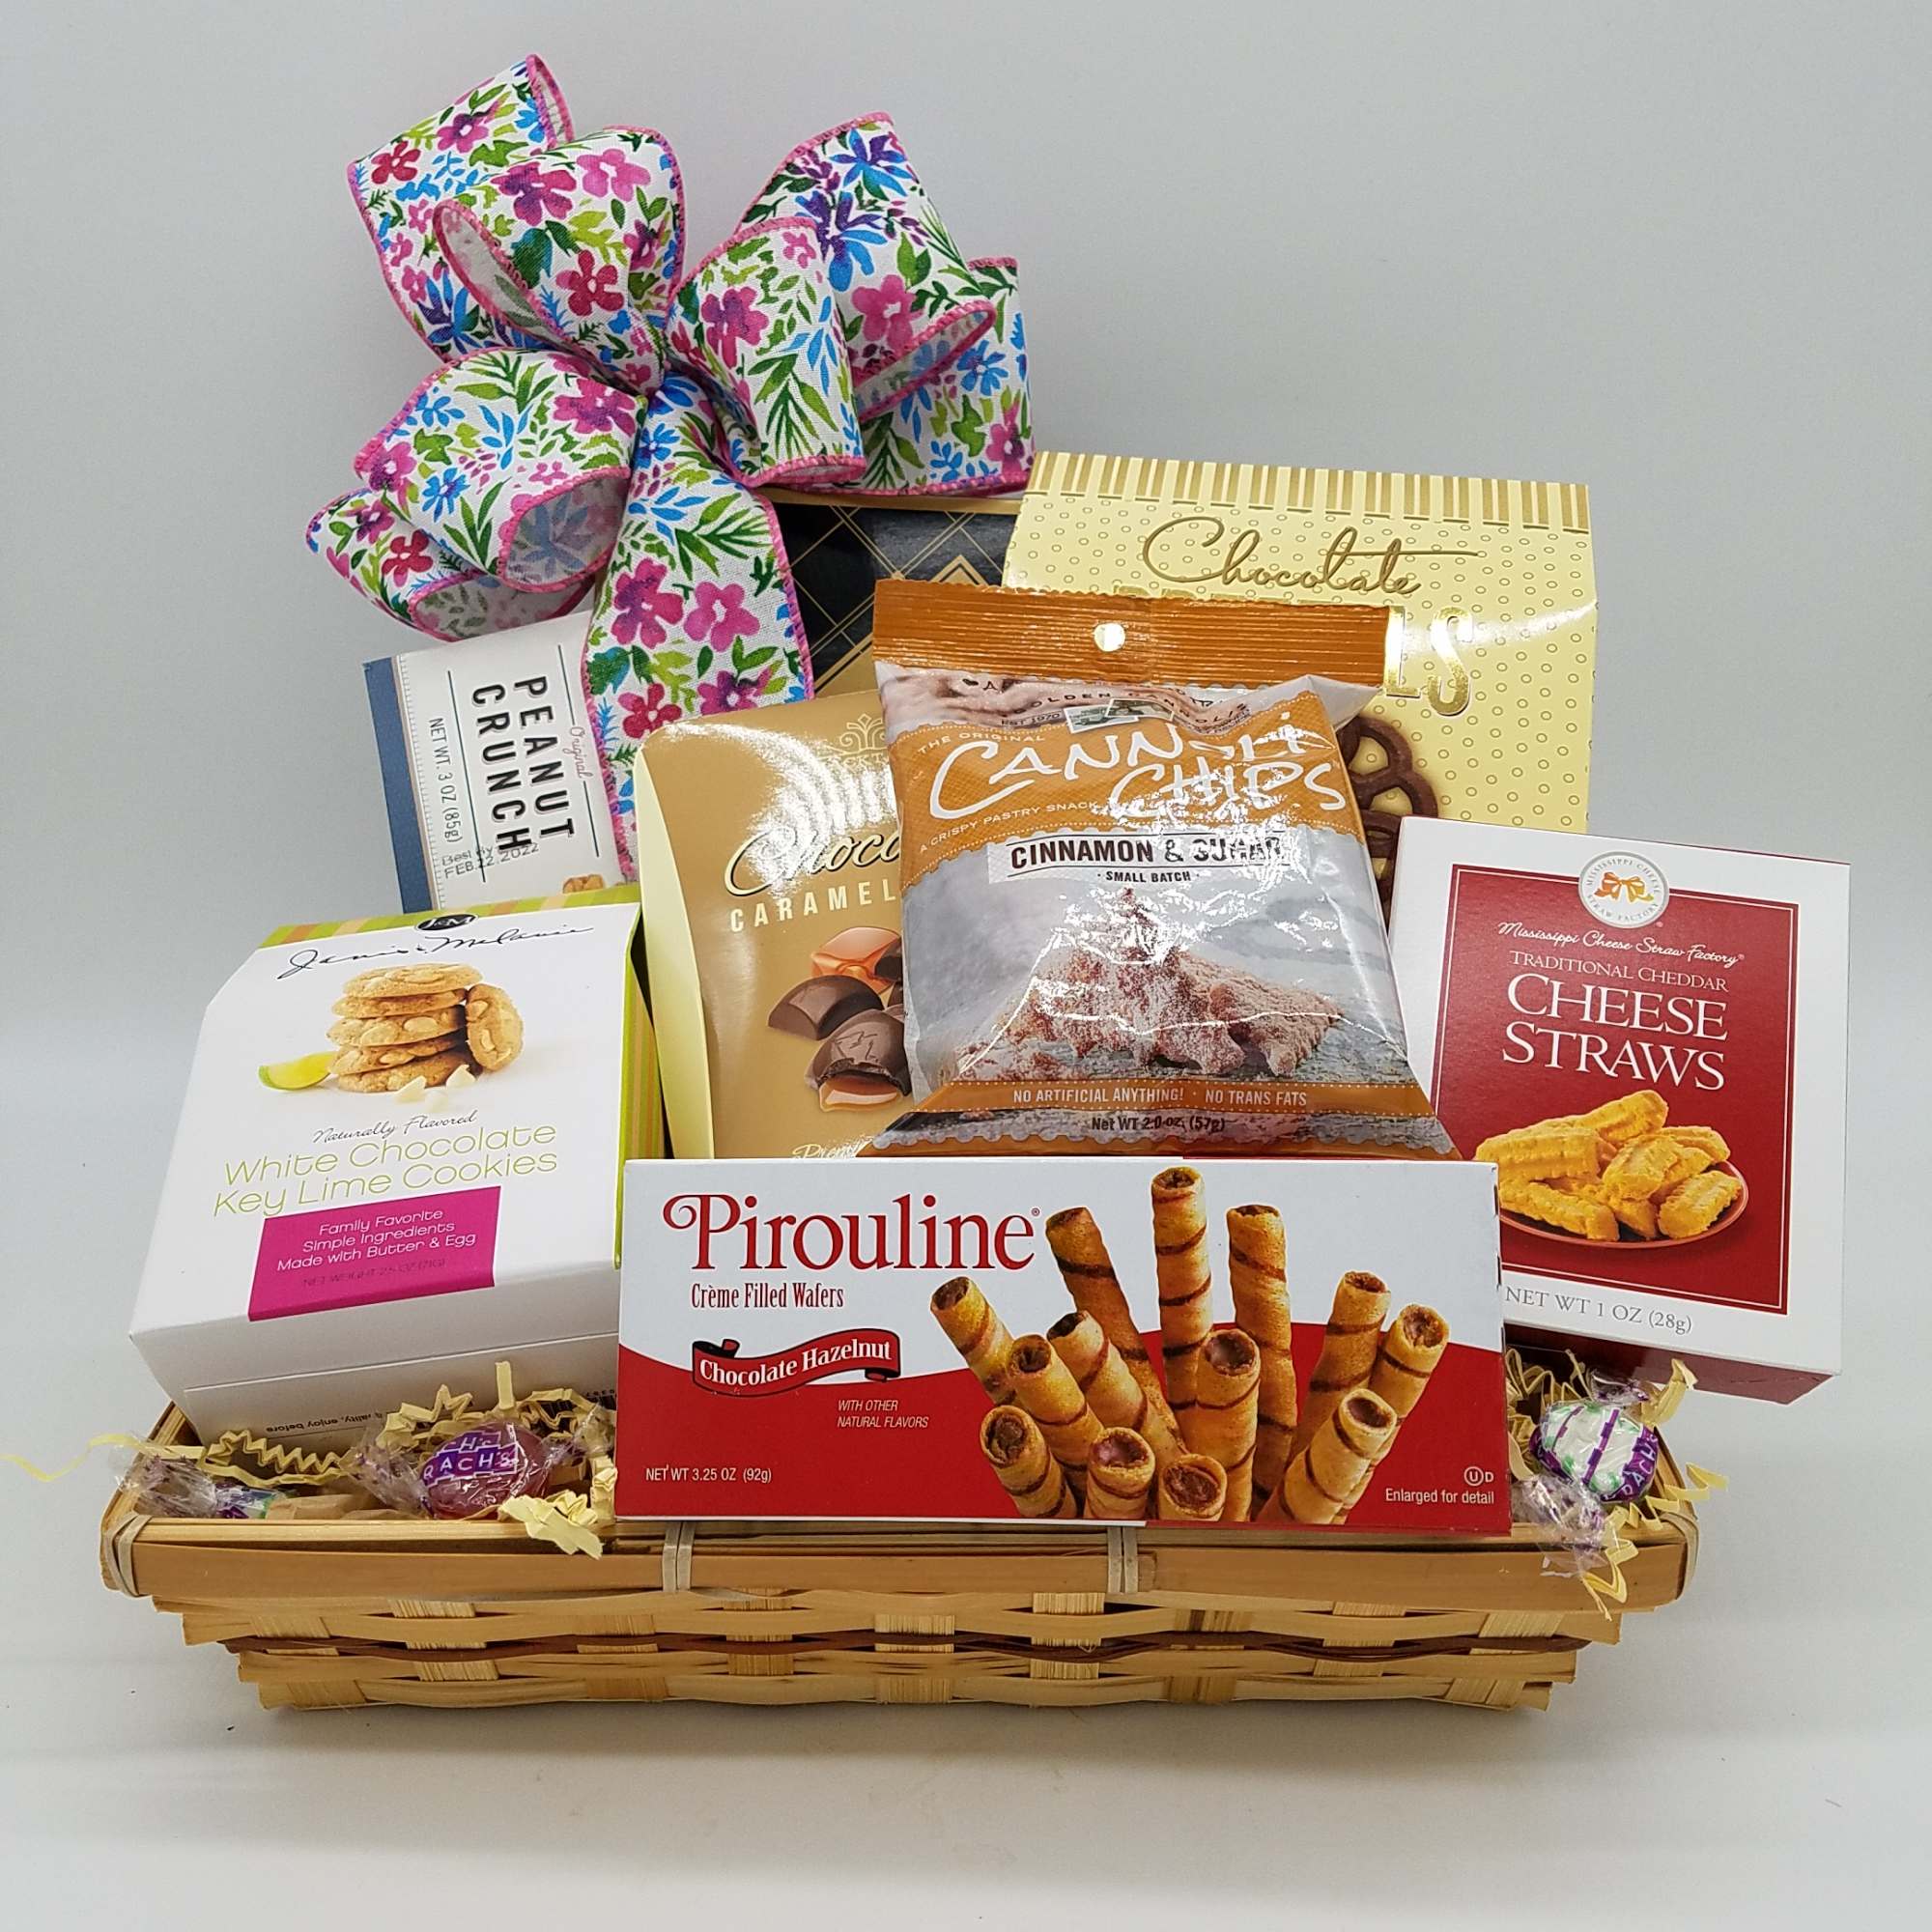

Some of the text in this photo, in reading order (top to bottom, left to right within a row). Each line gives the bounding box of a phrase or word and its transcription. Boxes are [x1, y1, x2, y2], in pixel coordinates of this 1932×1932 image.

[1143, 516, 1479, 595] Chocolate
[429, 718, 446, 743] NET
[918, 732, 1046, 754] THE ORIGINAL
[472, 684, 532, 852] CRUNCH
[514, 676, 575, 838] PEANUT
[438, 772, 453, 781] 3
[440, 784, 457, 803] OZ
[1109, 756, 1347, 818] CHIPS
[442, 808, 463, 843] (85g)
[919, 844, 929, 854] A
[930, 821, 978, 845] CRISPY
[983, 807, 1041, 825] PASTRY
[1010, 839, 1154, 869] CINNAMON
[1164, 838, 1183, 863] &
[1106, 870, 1191, 883] SMALL BATCH
[1587, 858, 1662, 894] MISSISSIPPI CHEESE
[1617, 901, 1659, 921] FACTORY
[1498, 922, 1740, 969] Mississippi Cheese Straw Factory
[1509, 951, 1729, 992] TRADITIONAL CHEDDAR
[1508, 973, 1728, 1041] CHEESE
[1502, 1021, 1724, 1091] STRAWS
[1013, 1088, 1307, 1106] NO ARTIFICIAL ANYTHING! NO TRANS FATS
[313, 1110, 479, 1144] Naturally Flavored
[1092, 1117, 1115, 1130] Net
[1119, 1116, 1137, 1130] WT
[224, 1124, 556, 1186] White Chocolate
[213, 1152, 558, 1217] Key Lime Cookies
[302, 1222, 455, 1254] Simple Ingredients
[319, 1208, 444, 1236] Family Favorite
[663, 1193, 1035, 1270] Pirouline
[276, 1232, 477, 1272] Made with Butter & Egg
[692, 1283, 843, 1308] Crème Filled Wafers
[1505, 1286, 1692, 1336] NET WT 1 OZ (28g)
[700, 1339, 892, 1386] Chocolate Hazelnut
[837, 1416, 928, 1428] NATURAL FLAVORS
[838, 1400, 897, 1411] WITH OTHER
[645, 1467, 772, 1484] NET WT 3.25 OZ (92g)
[1385, 1488, 1494, 1505] Enlarged for detail
